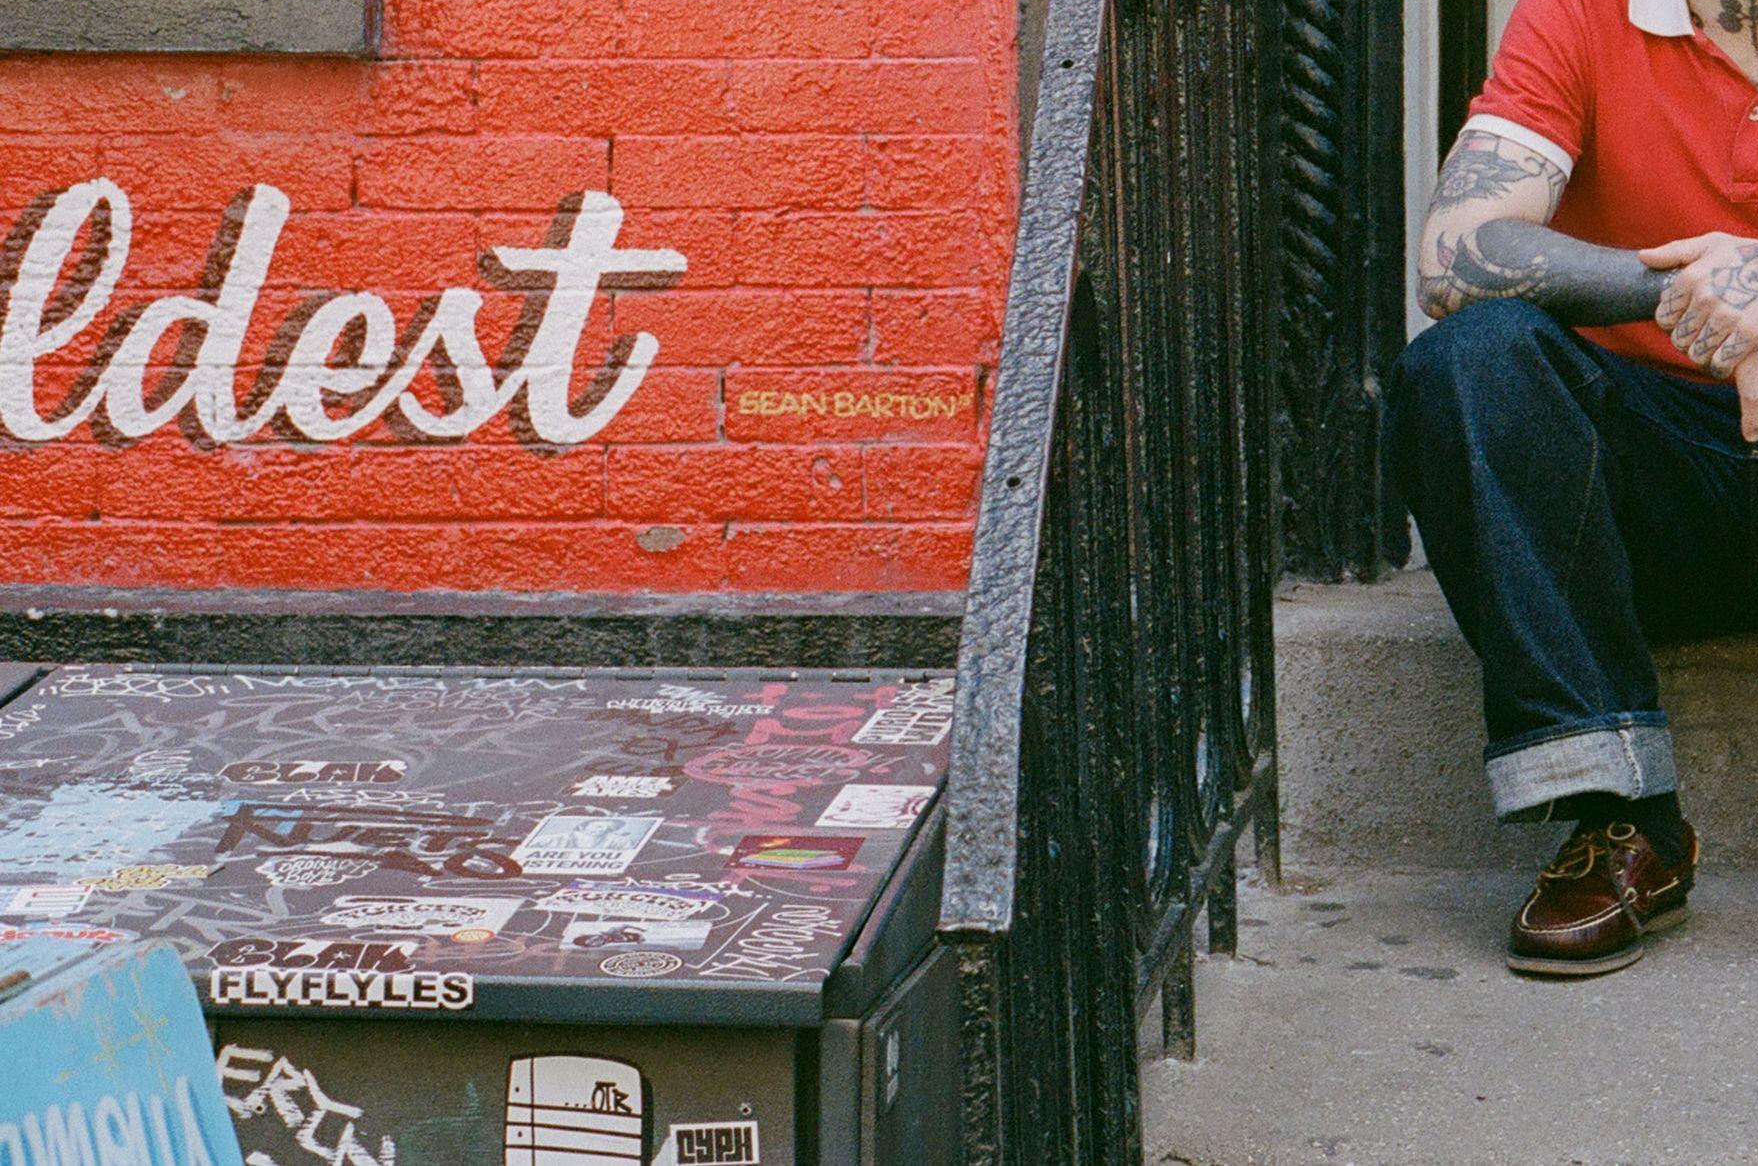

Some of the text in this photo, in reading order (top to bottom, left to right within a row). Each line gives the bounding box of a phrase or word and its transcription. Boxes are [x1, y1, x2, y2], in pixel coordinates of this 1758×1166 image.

[738, 390, 828, 416] SEAN
[525, 850, 623, 860] ARE YOU
[521, 859, 624, 870] ISTENING
[217, 969, 470, 1005] FLYFLYLES
